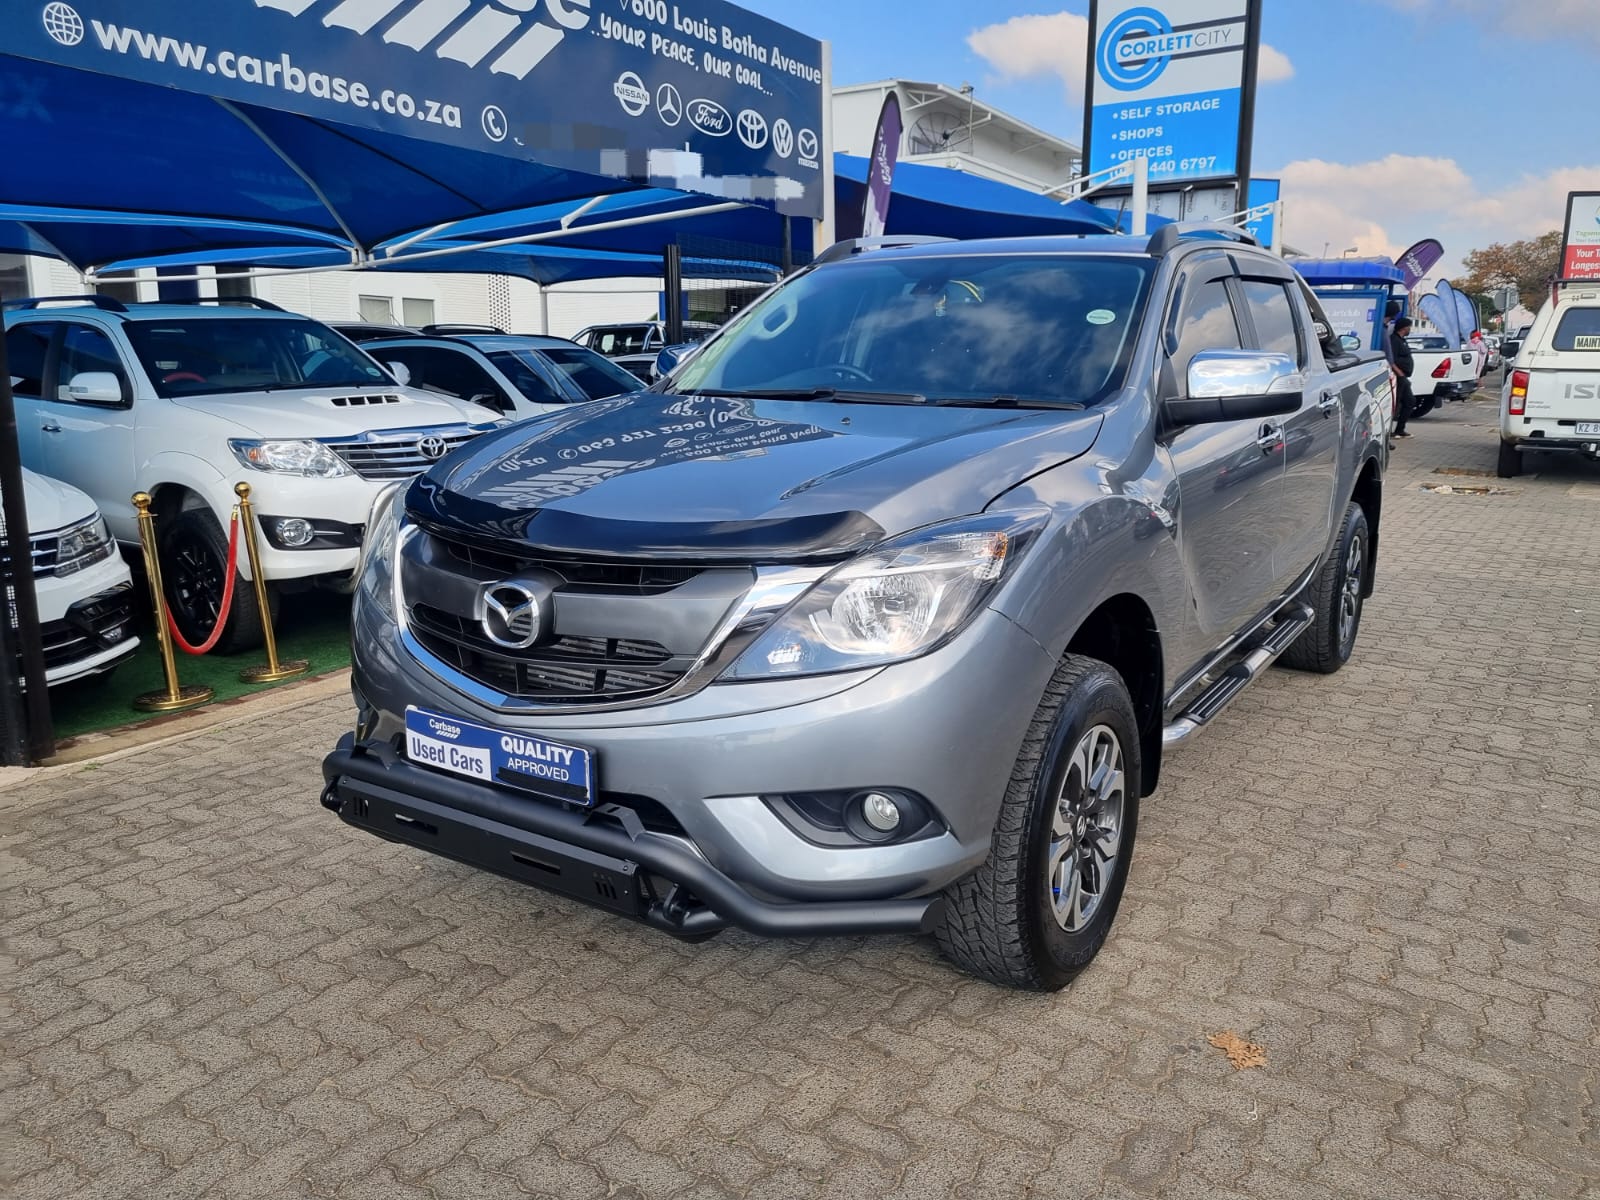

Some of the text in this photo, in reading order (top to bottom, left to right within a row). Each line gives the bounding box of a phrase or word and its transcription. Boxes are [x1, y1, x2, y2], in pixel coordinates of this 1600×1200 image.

[632, 0, 667, 25] 600
[673, 6, 717, 44] Louis
[722, 26, 767, 62] Botha
[770, 47, 822, 85] Avenue
[91, 19, 462, 129] www.carbase.co.za
[703, 52, 731, 79] OUR
[616, 86, 648, 102] NISSAN
[695, 104, 724, 130] Ford
[1120, 98, 1220, 120] SELF STORAGE
[1119, 126, 1163, 141] SHOPS
[1118, 145, 1173, 161] OFFICES
[1150, 156, 1216, 172] 440 6797
[1576, 249, 1594, 258] Your
[1564, 384, 1600, 399] IS
[1578, 424, 1590, 433] KZ
[429, 718, 461, 735] Carbase
[412, 737, 483, 774] Used Cars
[501, 735, 573, 766] QUALITY
[507, 757, 570, 782] APPROVED
